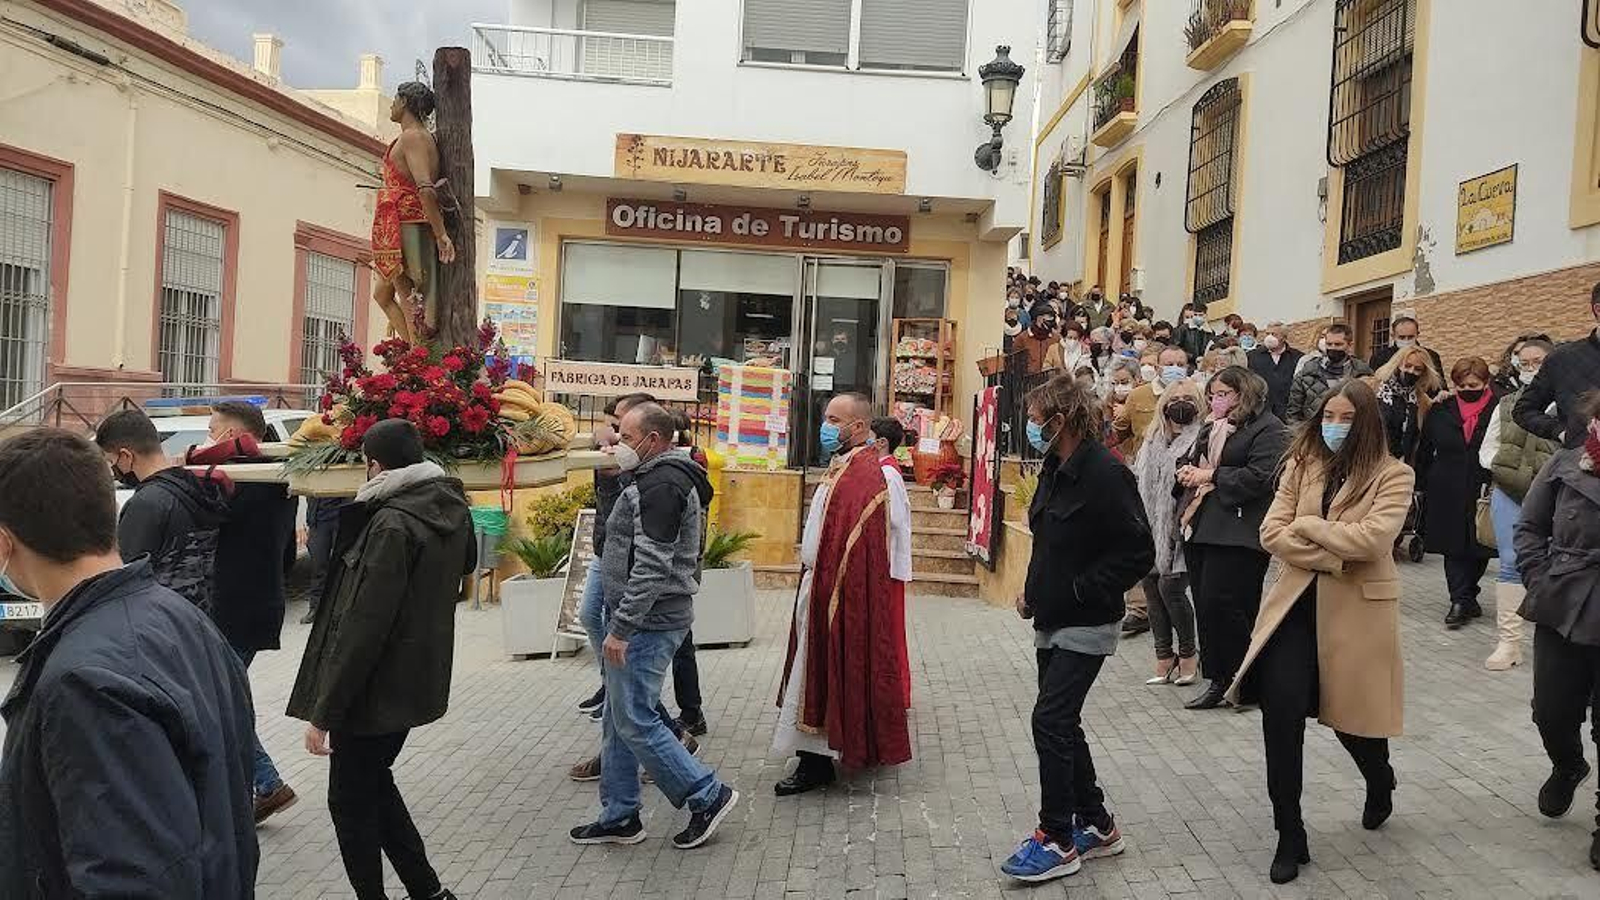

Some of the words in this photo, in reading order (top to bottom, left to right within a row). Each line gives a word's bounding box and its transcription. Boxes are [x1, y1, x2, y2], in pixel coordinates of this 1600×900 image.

[1478, 180, 1514, 202] Cueva
[612, 204, 722, 234] Oficina
[732, 213, 769, 236] de
[779, 215, 902, 244] Turismo
[610, 374, 630, 388] DE
[632, 376, 692, 391] JARAPAS
[7, 605, 39, 617] 8217
